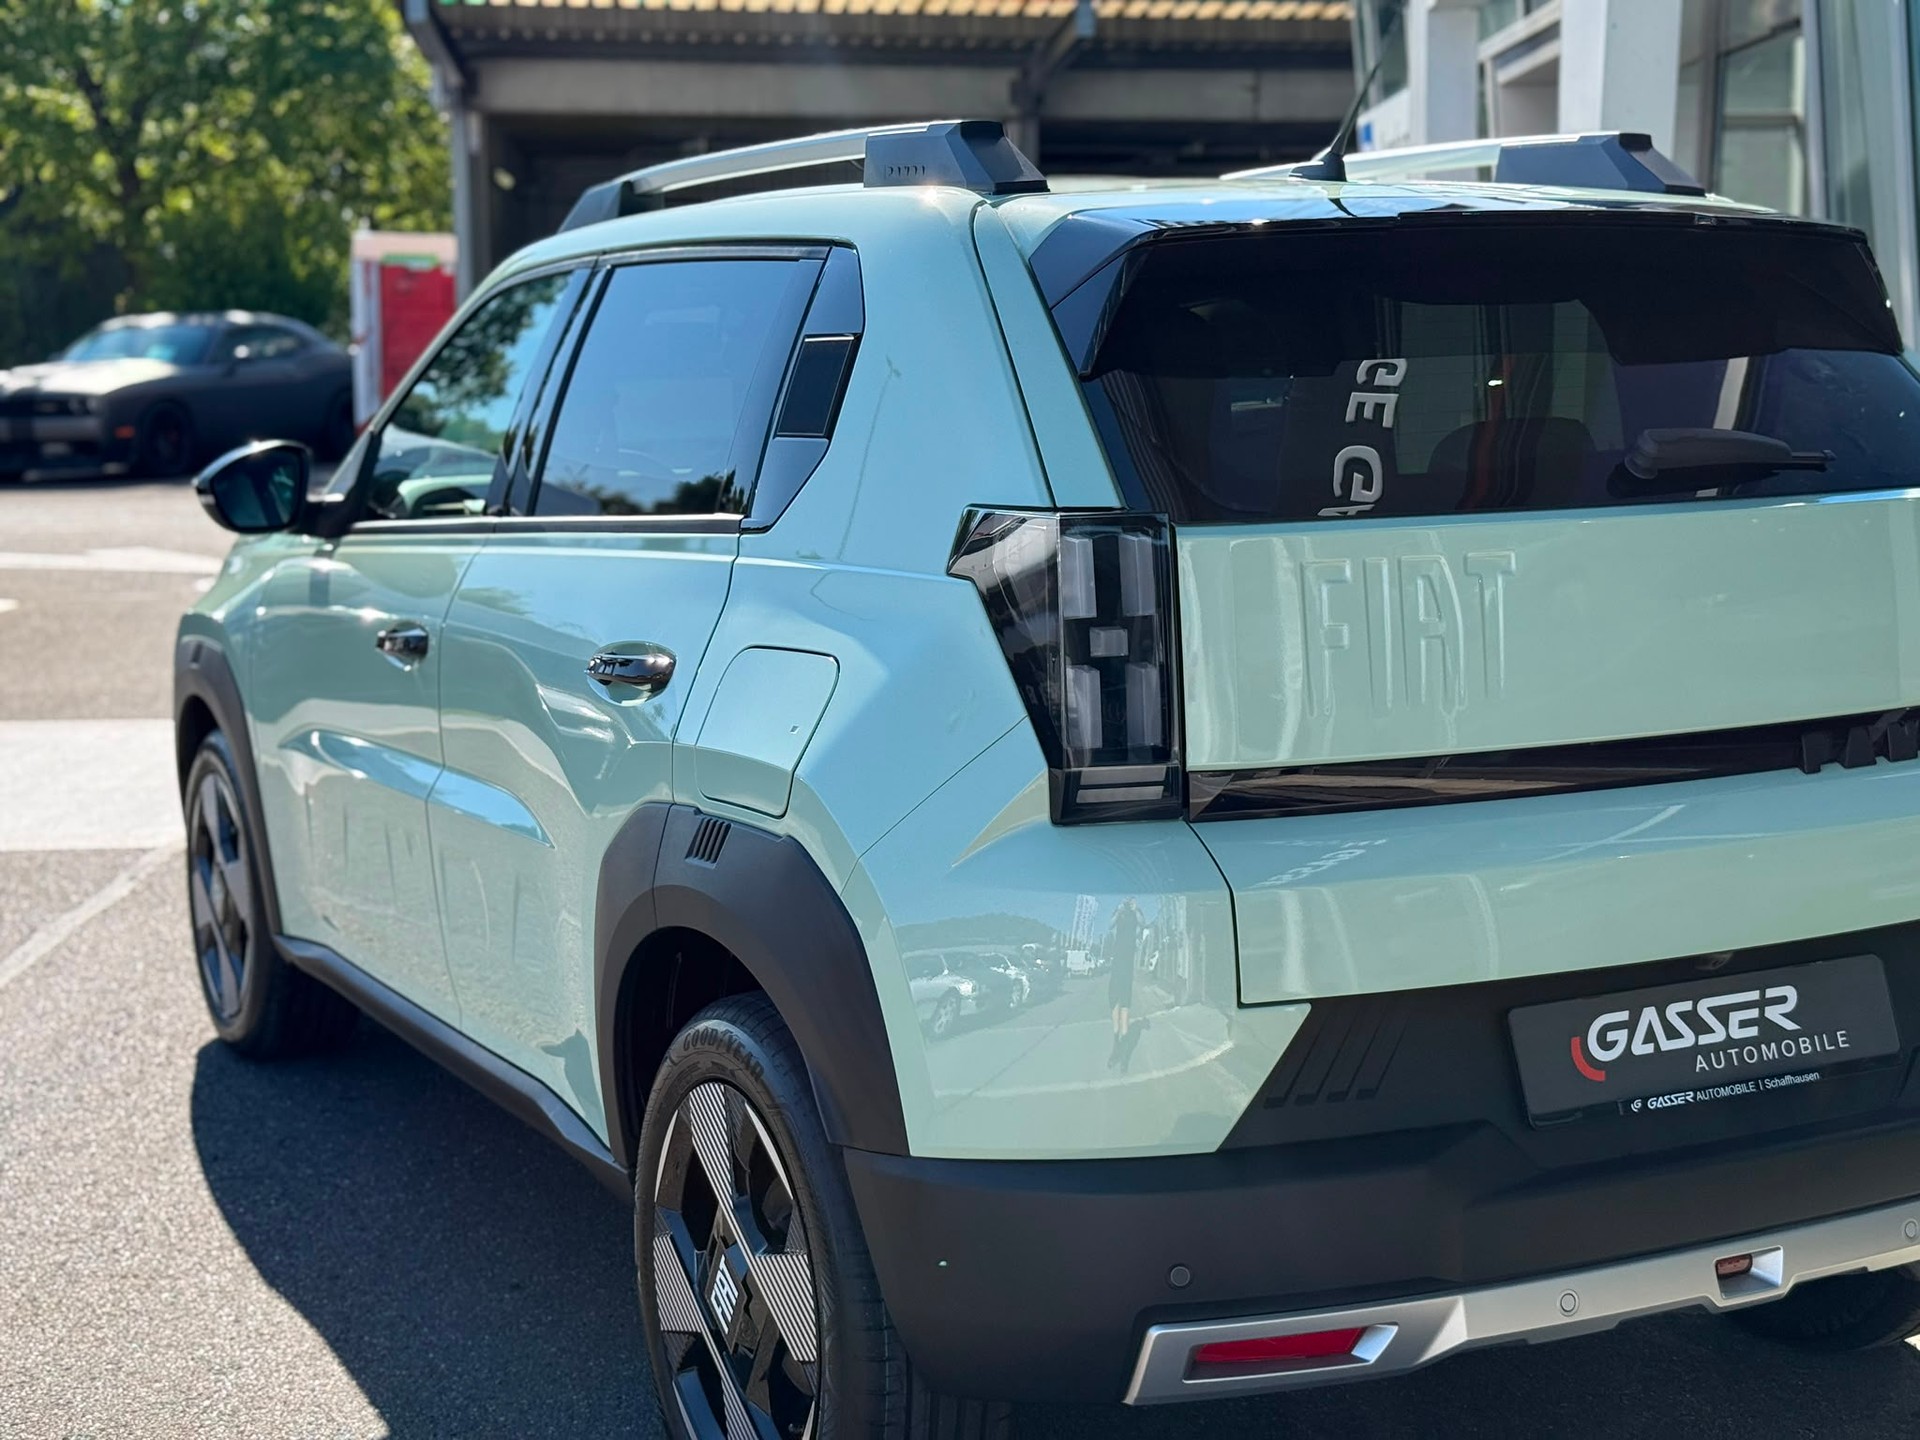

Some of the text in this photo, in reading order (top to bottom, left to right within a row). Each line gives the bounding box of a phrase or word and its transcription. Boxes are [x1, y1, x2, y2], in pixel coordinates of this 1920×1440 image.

[1301, 549, 1516, 718] FIAT
[1586, 985, 1802, 1062] GASSER
[1695, 1030, 1850, 1072] AUTOMOBILE
[1647, 1091, 1694, 1110] GASSER
[1696, 1081, 1757, 1102] AUTOMOBILE
[1764, 1070, 1820, 1090] Schaffhausen
[710, 1254, 739, 1335] FIAT
